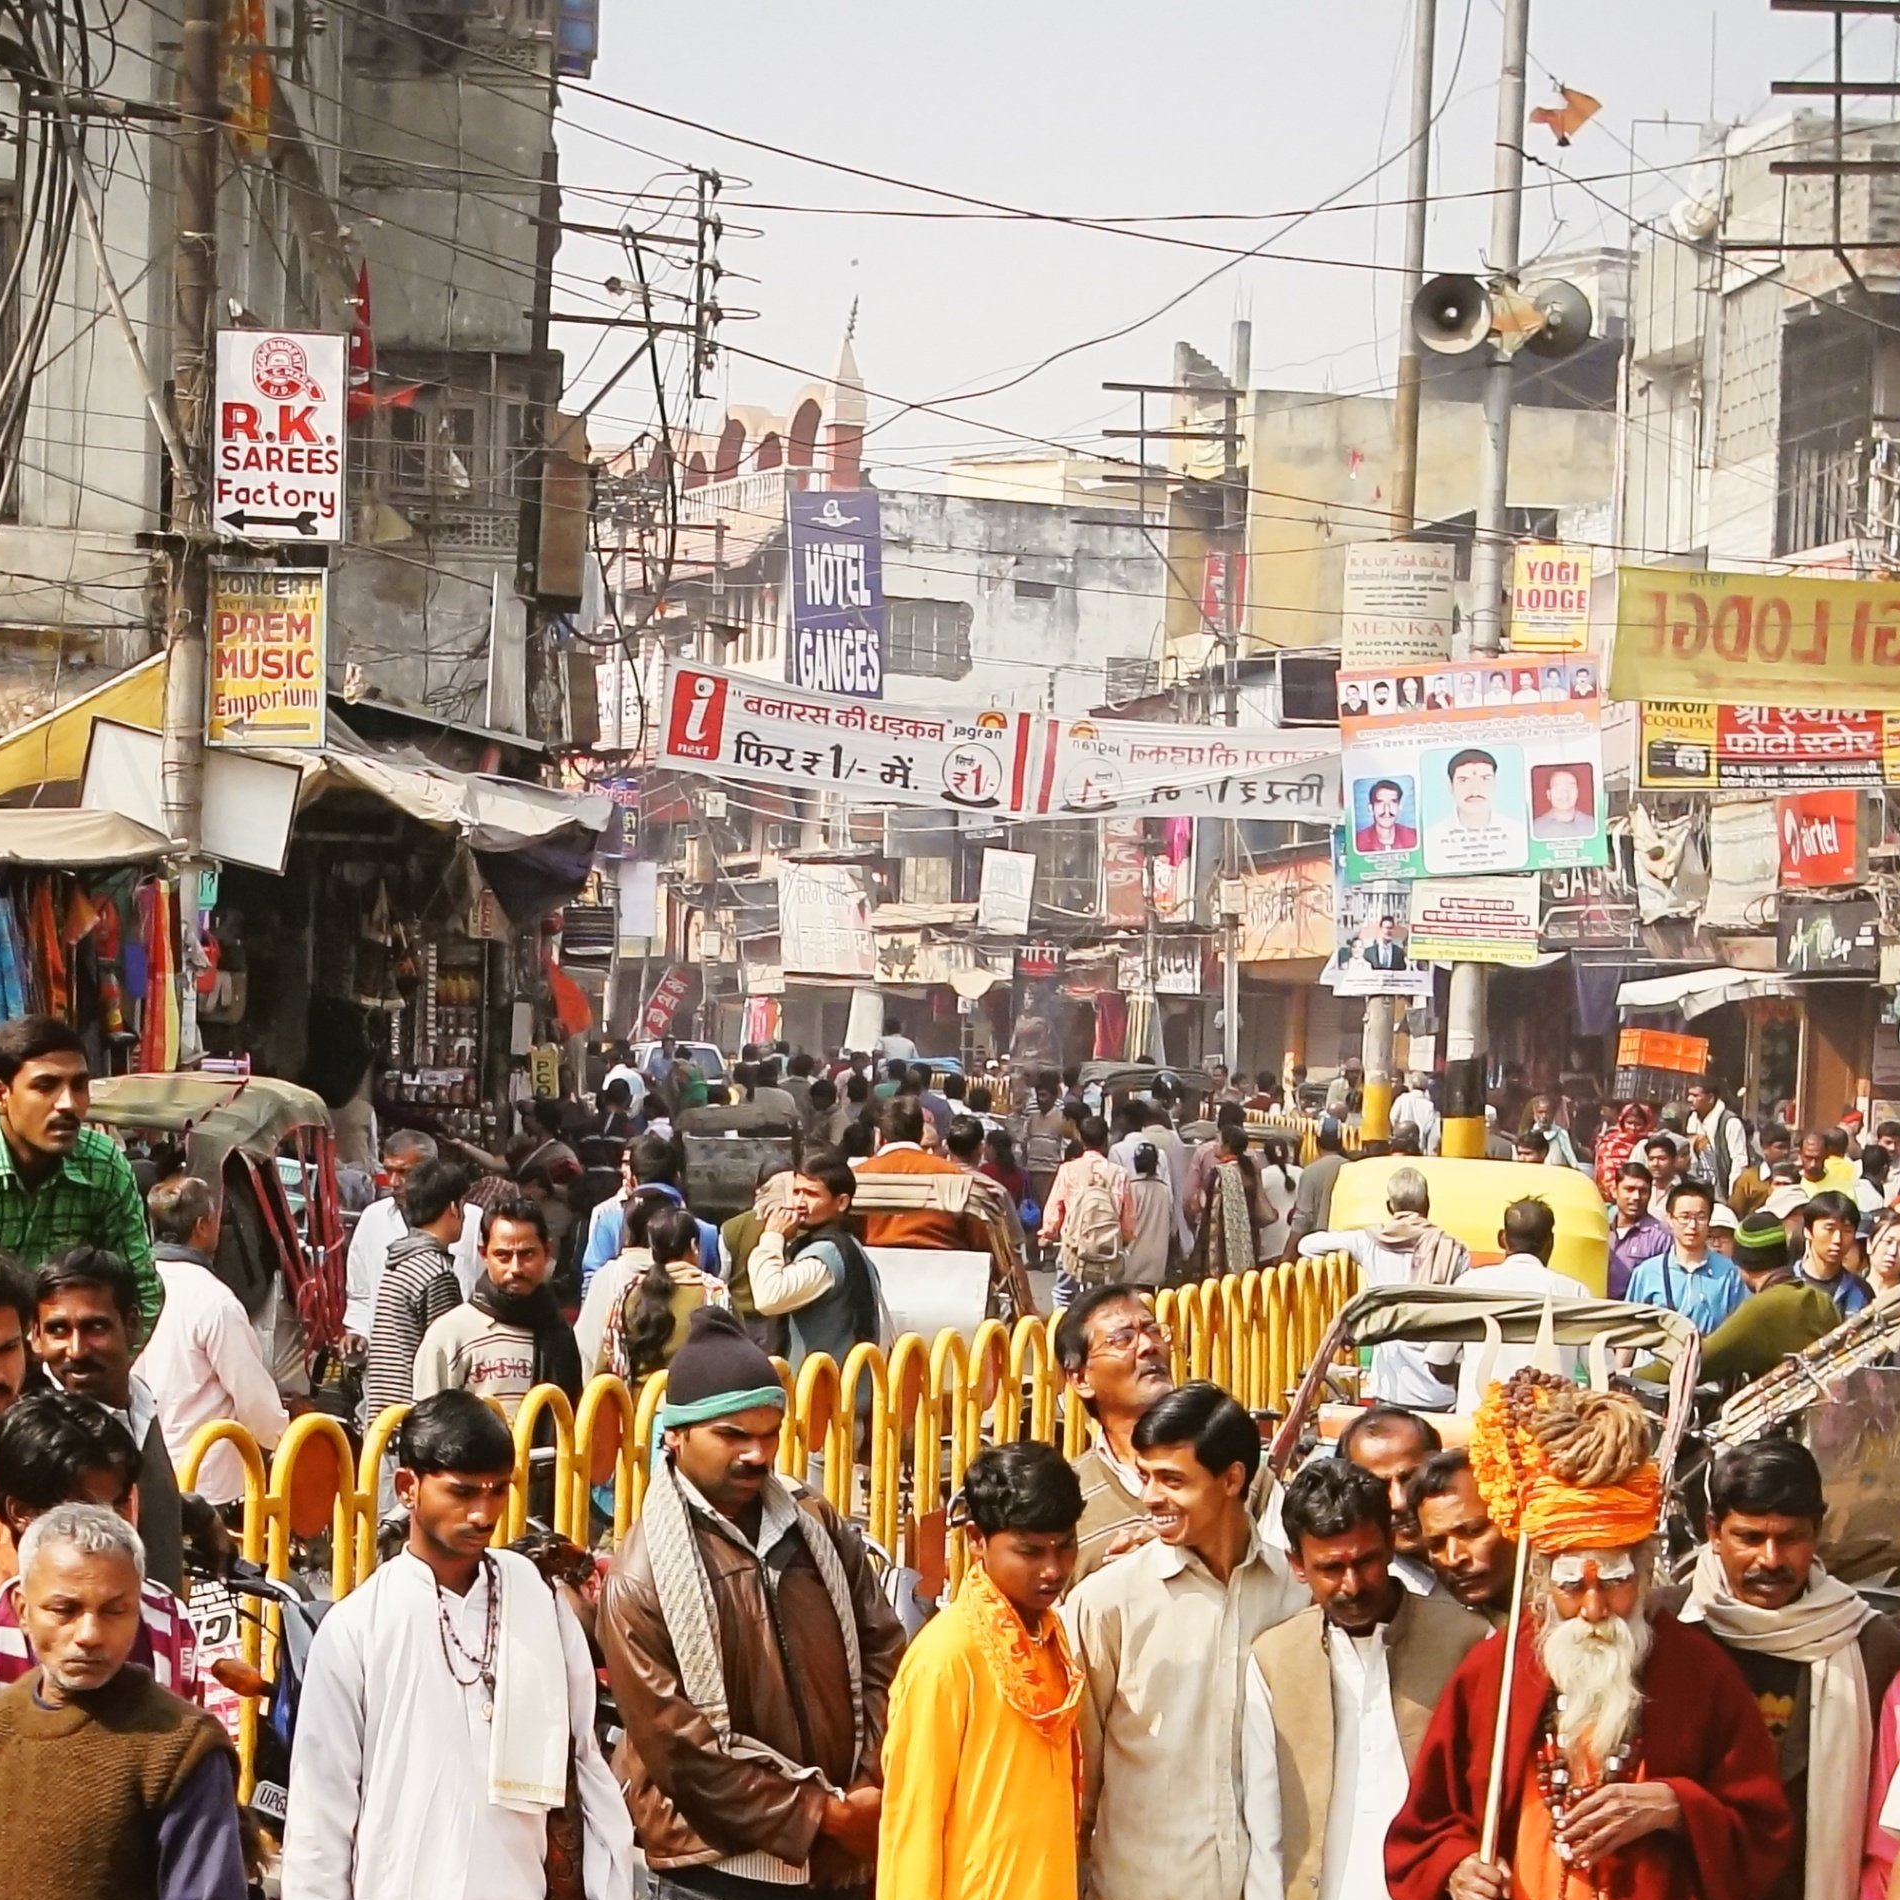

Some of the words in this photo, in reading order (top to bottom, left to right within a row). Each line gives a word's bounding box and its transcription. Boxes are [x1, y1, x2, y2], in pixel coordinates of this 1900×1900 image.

[221, 401, 336, 446] R.K.
[221, 445, 338, 476] SAREES
[217, 478, 336, 519] Factory
[804, 542, 872, 607] HOTEL
[1527, 561, 1580, 583] YOGI
[1516, 588, 1587, 610] LODGE
[215, 611, 314, 645] PREM
[1350, 622, 1445, 637] MENKA
[215, 647, 315, 680] MUSIC
[799, 627, 880, 692] GANGES
[214, 682, 319, 719] Emporium
[836, 705, 868, 731] की
[953, 724, 1003, 741] jagran
[1643, 714, 1716, 730] COOLPIX
[676, 742, 710, 757] next
[734, 731, 797, 773] फिर
[1724, 725, 1797, 754] फोटो
[1799, 724, 1876, 754] स्टोर
[1801, 815, 1840, 857] airtel
[535, 1060, 552, 1097] PCO
